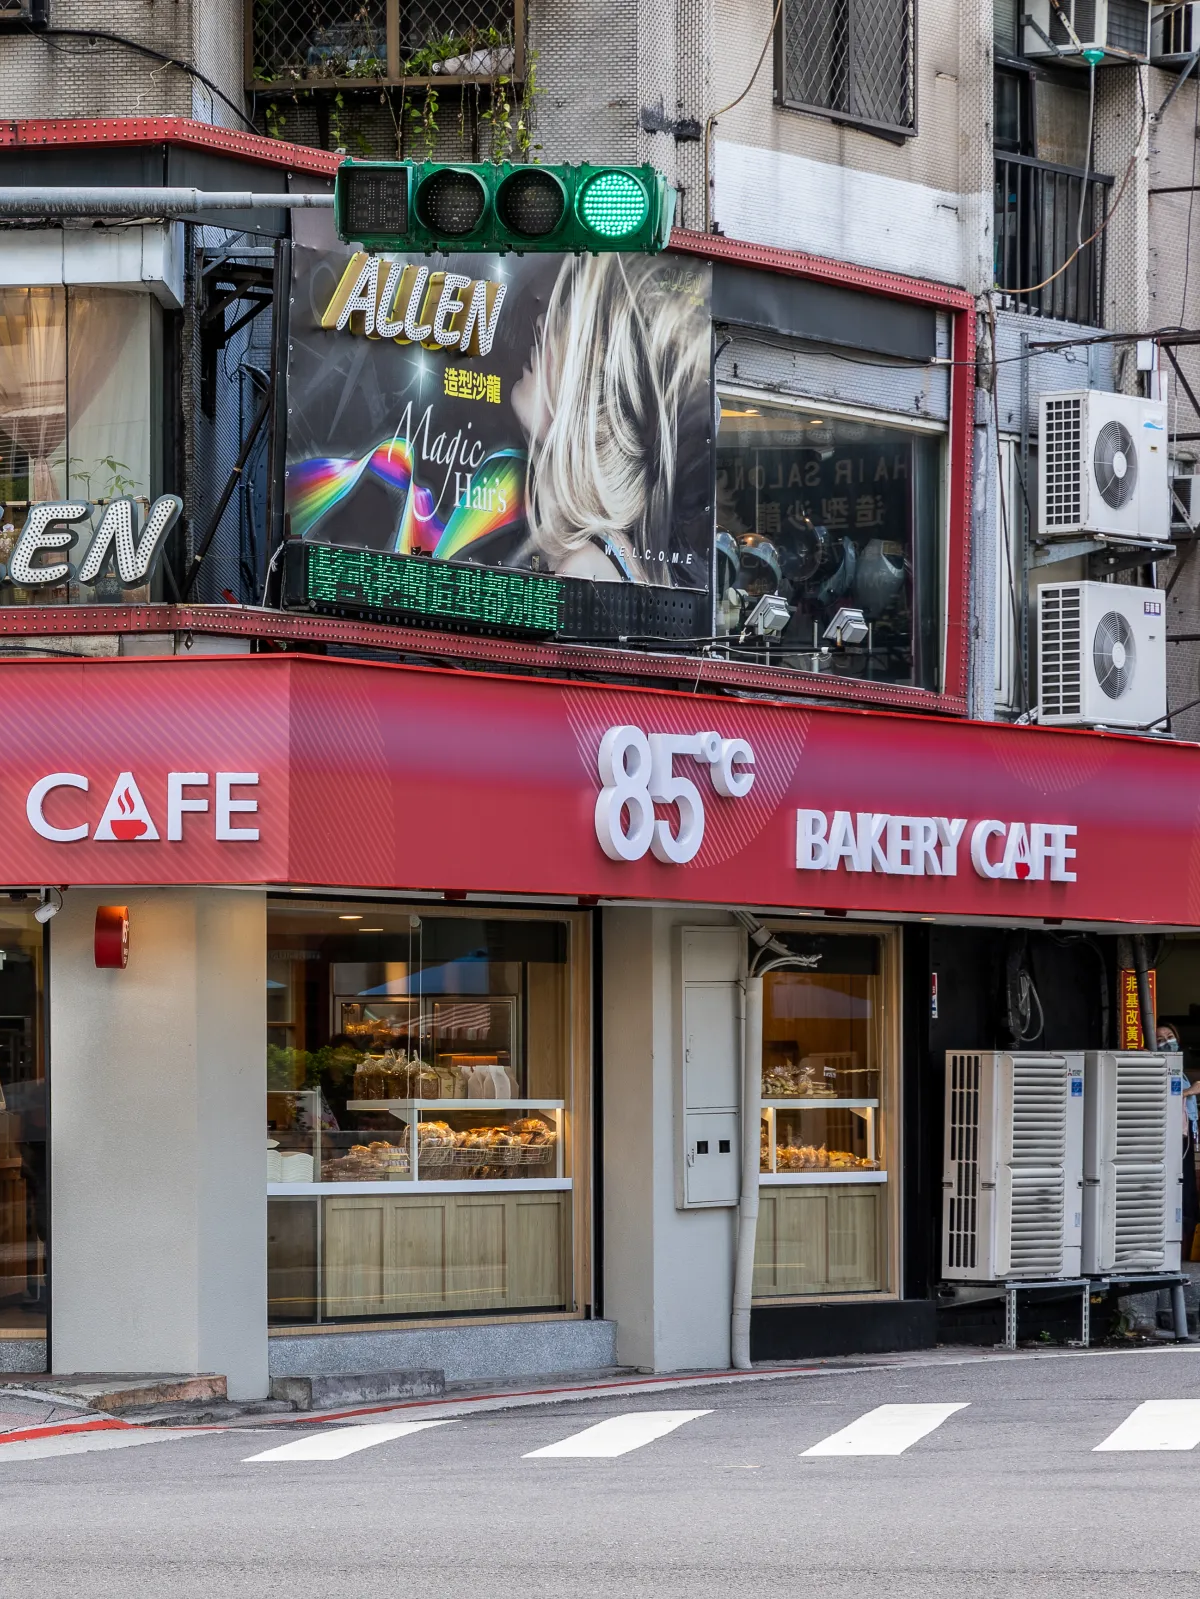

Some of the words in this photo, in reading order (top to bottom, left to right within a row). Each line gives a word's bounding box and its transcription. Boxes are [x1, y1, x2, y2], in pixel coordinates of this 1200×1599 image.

[324, 251, 507, 356] ALLEN
[443, 366, 501, 404] 造型沙龍
[387, 400, 486, 523] Magic
[453, 471, 507, 514] Hair's
[25, 771, 260, 843] CAFE
[796, 807, 968, 877] BAKERY
[971, 818, 1078, 883] CAFE
